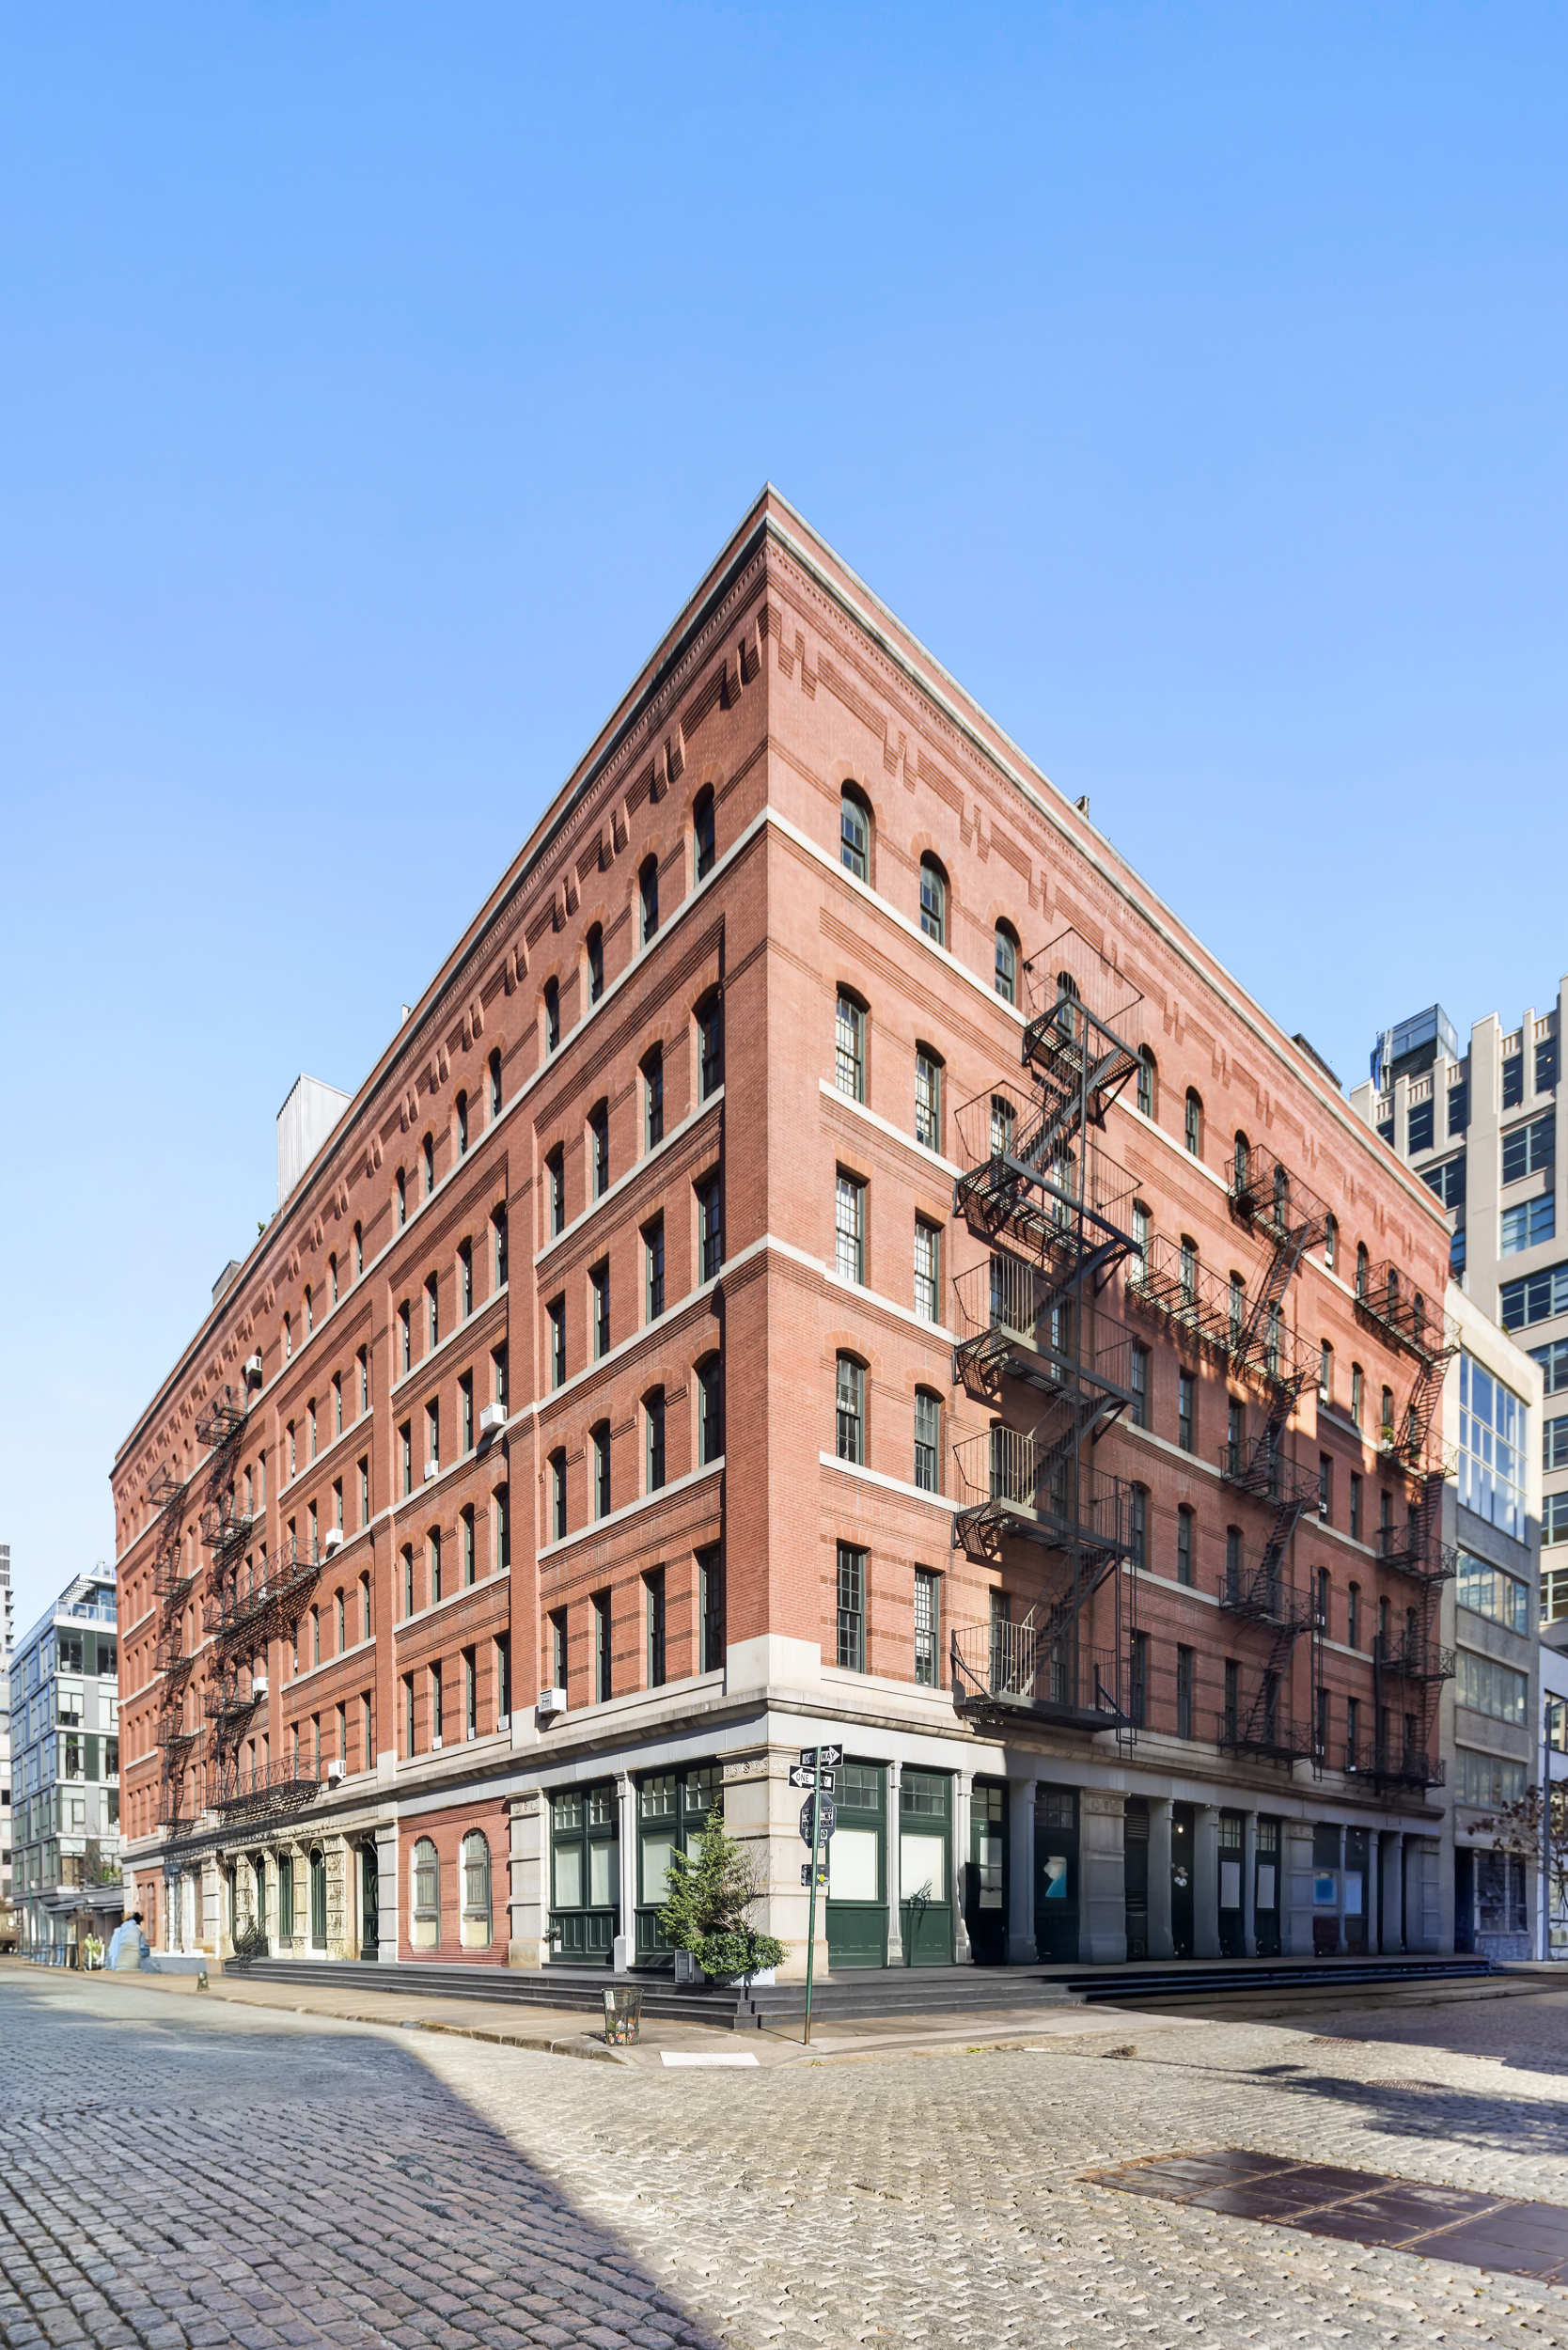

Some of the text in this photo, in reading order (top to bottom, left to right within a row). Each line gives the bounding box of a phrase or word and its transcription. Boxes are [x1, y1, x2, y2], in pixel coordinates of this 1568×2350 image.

[806, 1751, 836, 1763] ONE WAY
[796, 1772, 809, 1783] ONE
